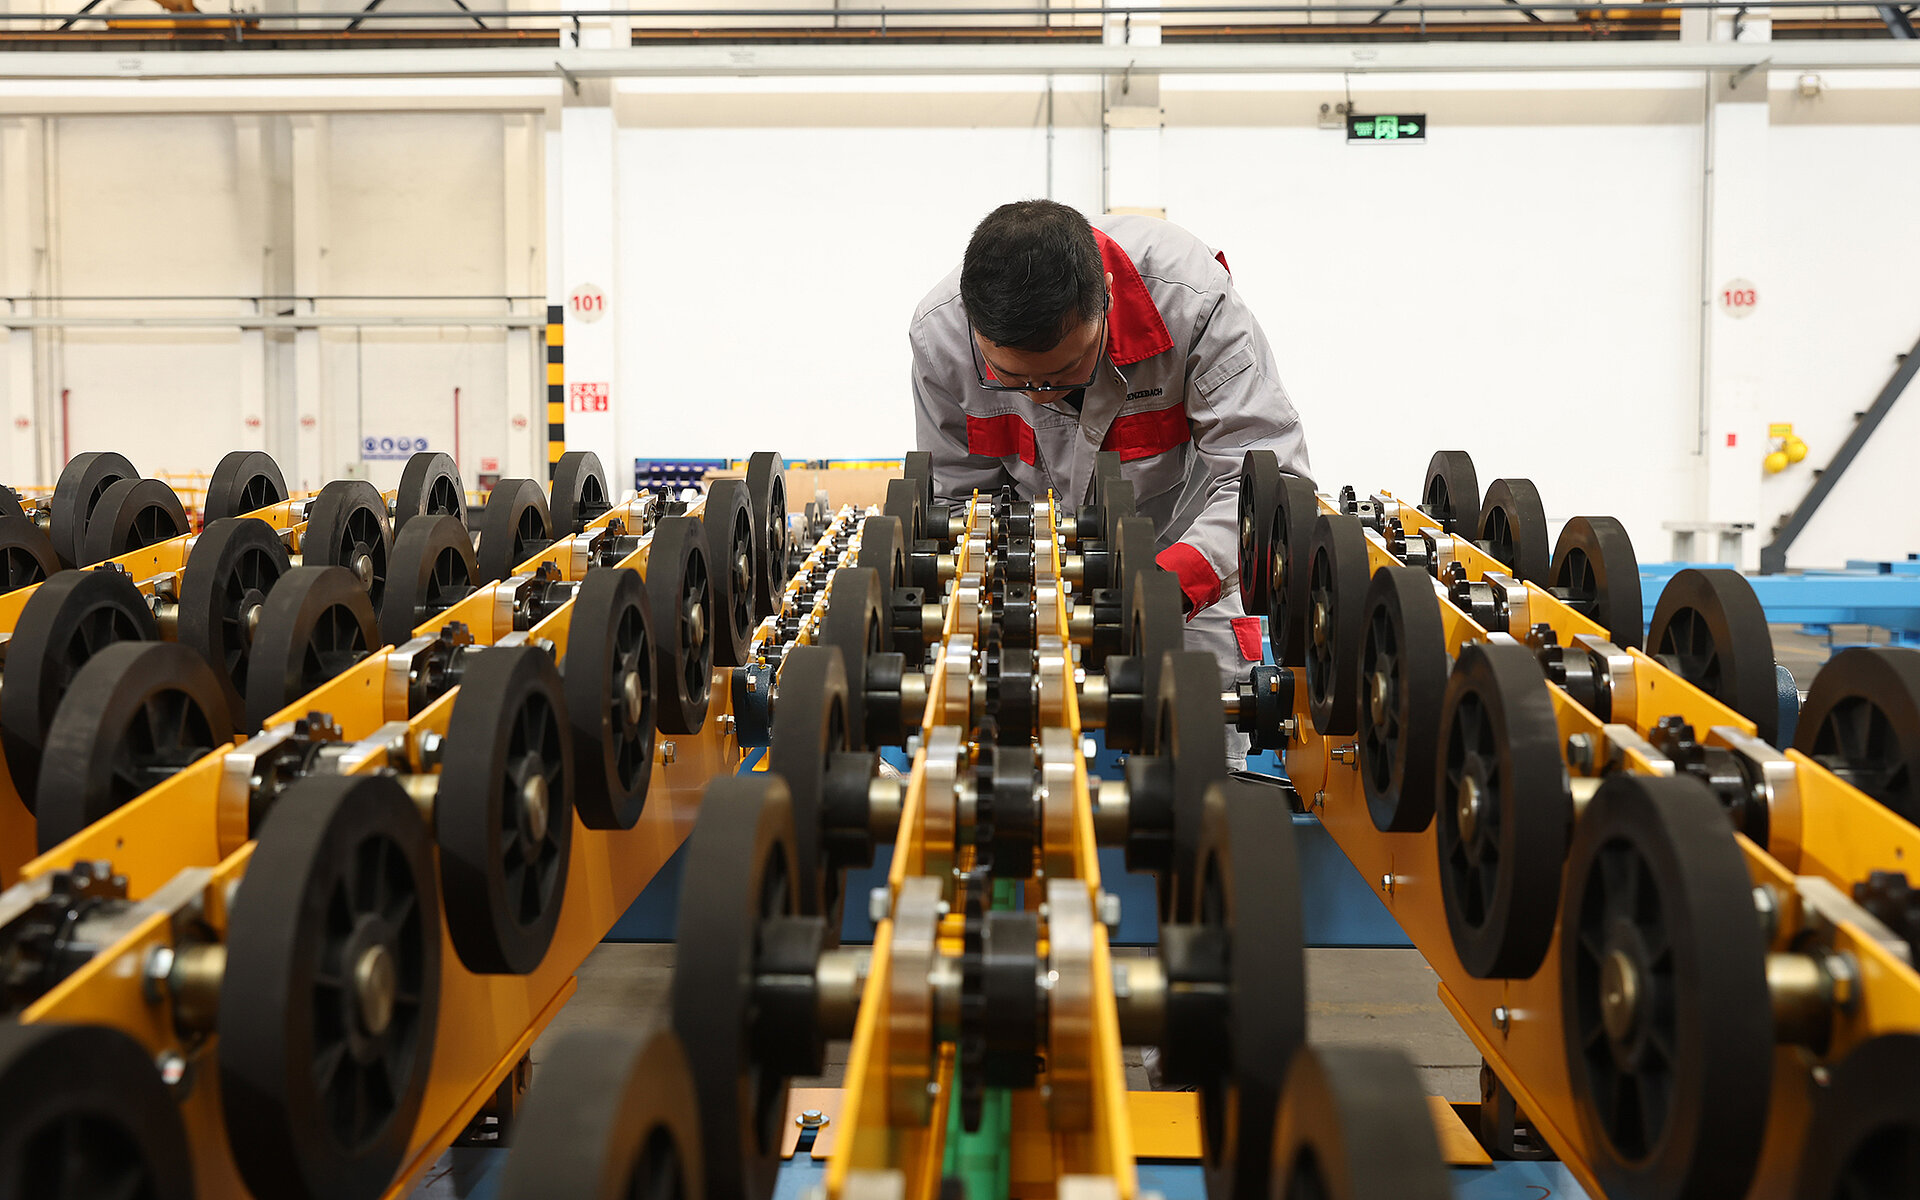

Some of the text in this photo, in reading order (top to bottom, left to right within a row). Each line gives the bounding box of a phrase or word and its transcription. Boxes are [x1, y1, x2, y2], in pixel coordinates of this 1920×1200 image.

[573, 295, 602, 311] 101
[1724, 290, 1756, 307] 103
[1126, 388, 1163, 401] ENZEBACH
